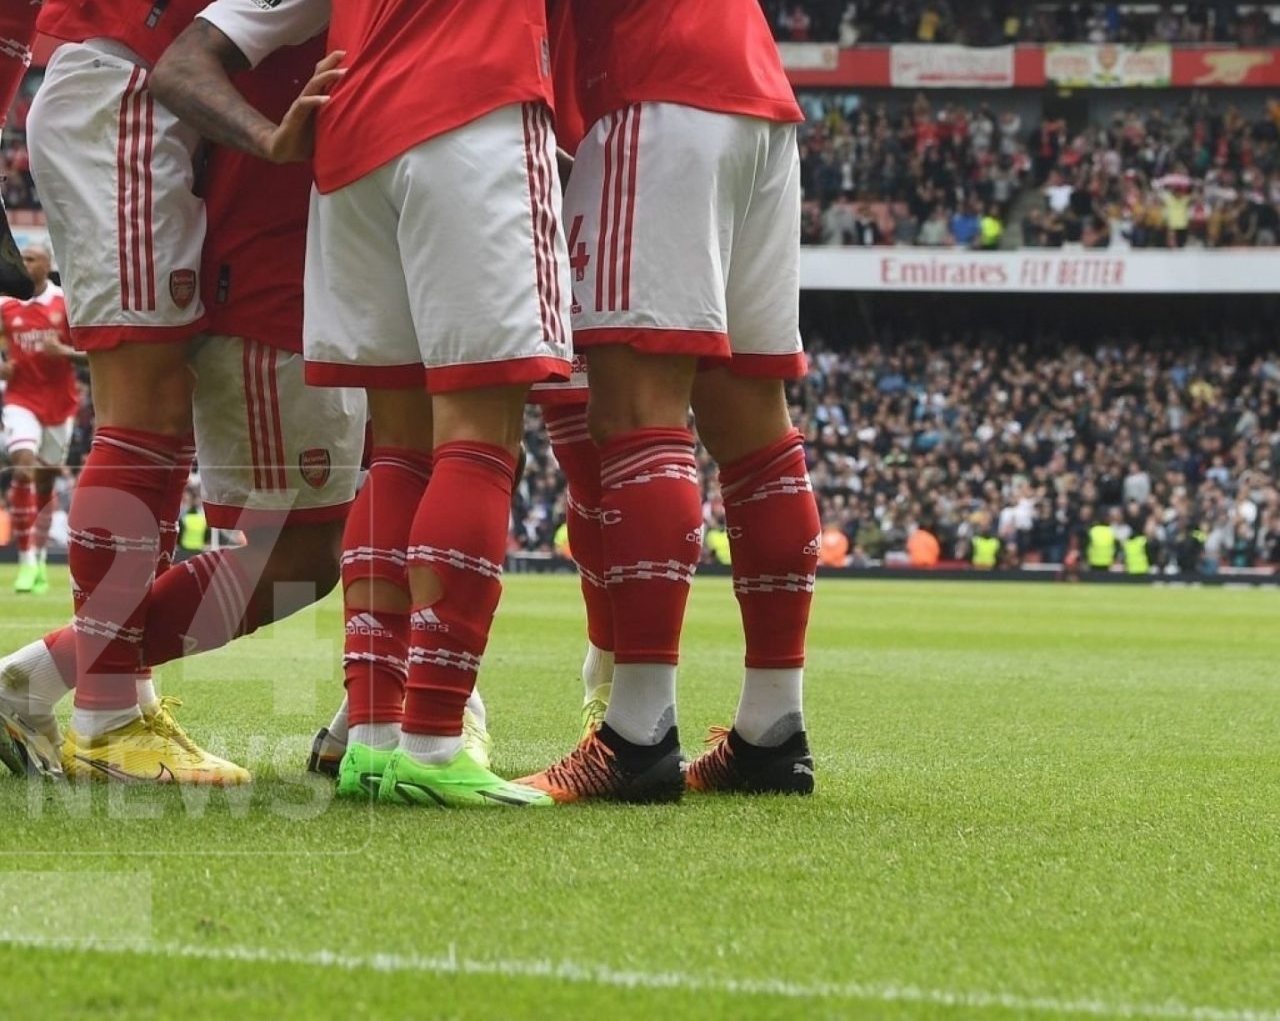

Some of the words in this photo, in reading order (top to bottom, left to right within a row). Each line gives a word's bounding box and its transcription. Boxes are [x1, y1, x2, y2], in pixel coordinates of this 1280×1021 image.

[880, 257, 1008, 285] Emirates
[1020, 259, 1051, 285] FLY
[1056, 259, 1125, 286] BETTER
